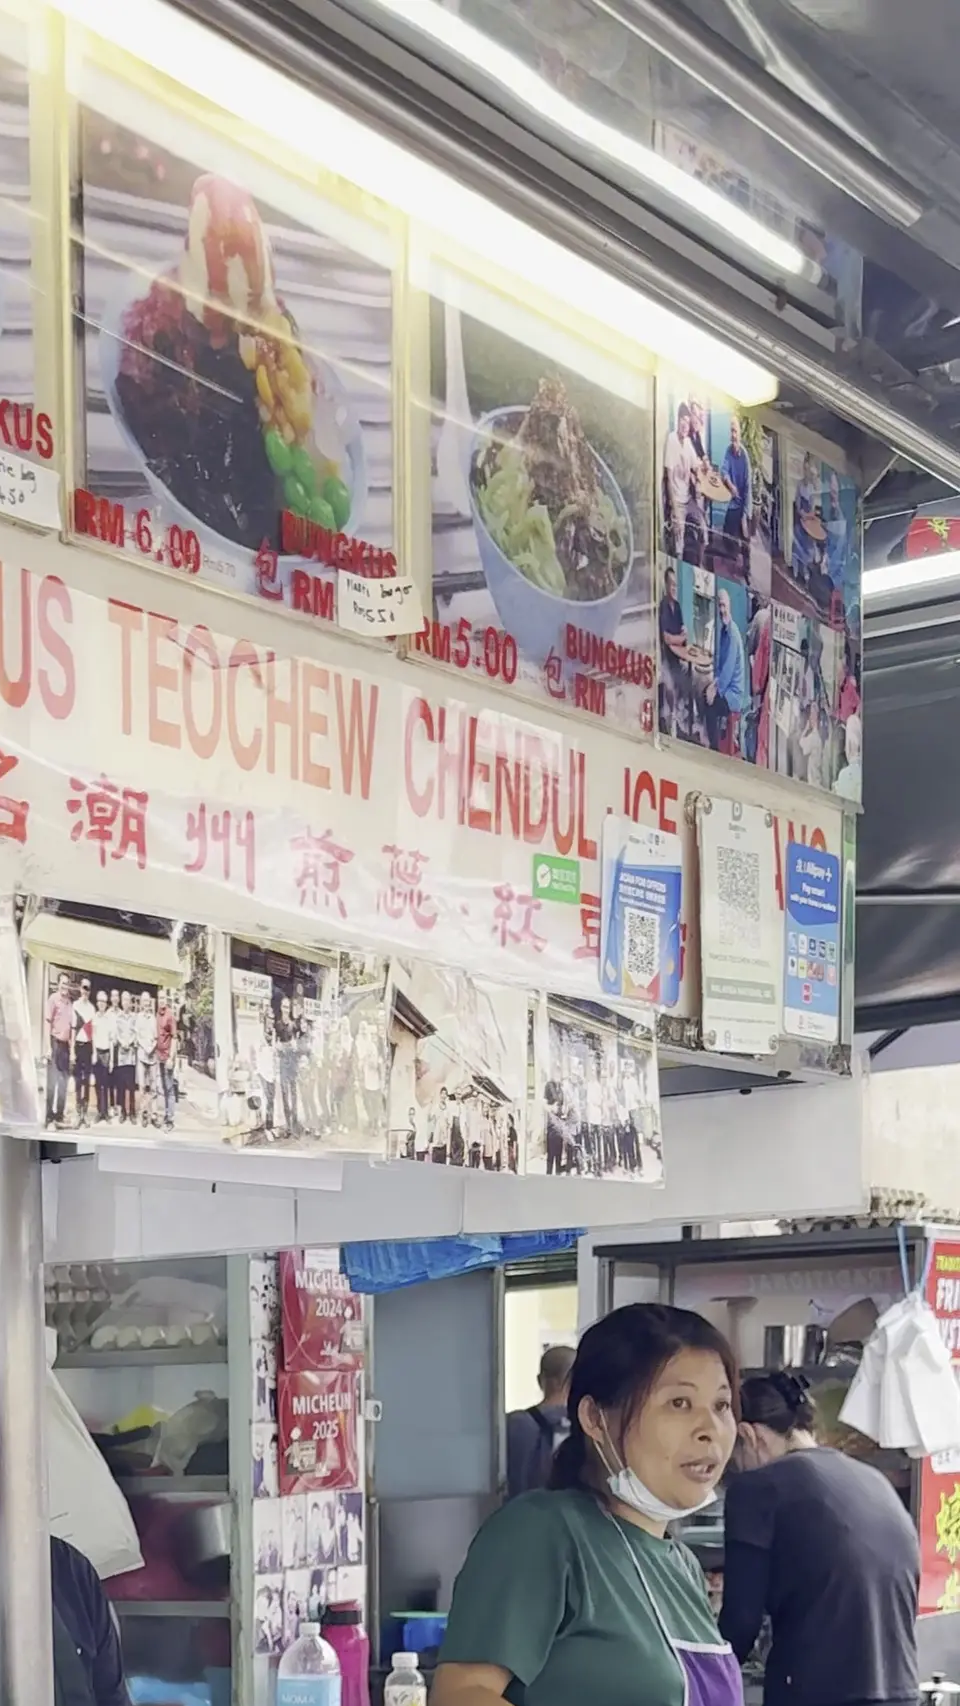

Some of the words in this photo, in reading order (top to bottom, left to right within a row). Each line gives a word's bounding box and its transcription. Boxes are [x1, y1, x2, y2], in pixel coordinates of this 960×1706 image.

[281, 508, 397, 579] BUNGKUS
[291, 569, 335, 622] RM
[565, 623, 654, 689] BUNGKUS
[575, 673, 606, 717] RM
[108, 599, 379, 800] TEOCHEW
[405, 697, 597, 861] CHENDUL
[316, 1299, 343, 1317] 2024
[292, 1392, 352, 1415] MICHELIN
[312, 1420, 339, 1440] 2025
